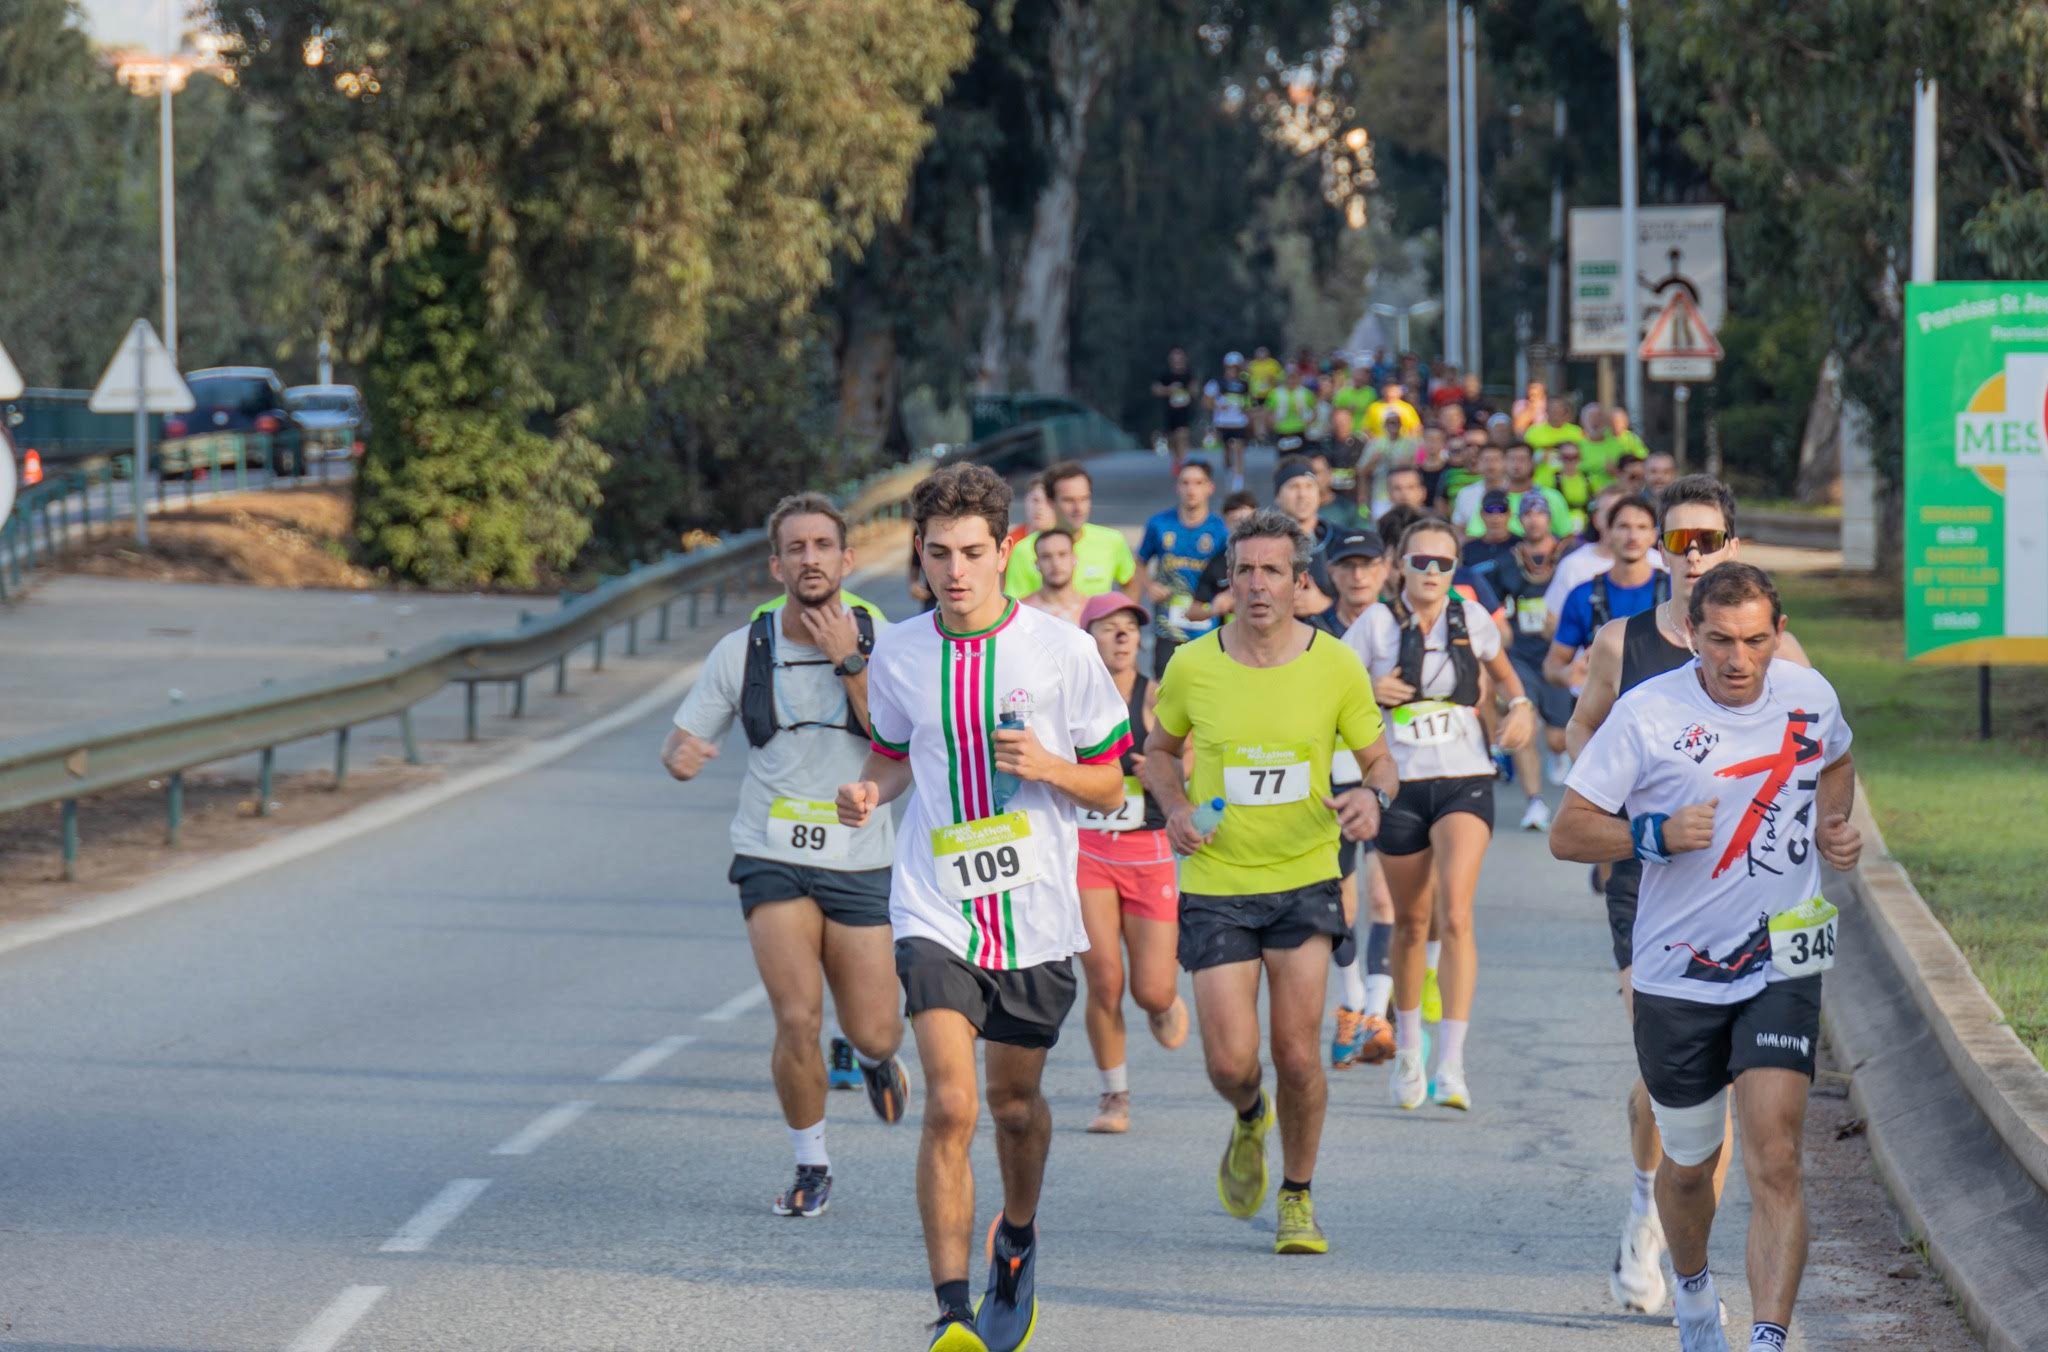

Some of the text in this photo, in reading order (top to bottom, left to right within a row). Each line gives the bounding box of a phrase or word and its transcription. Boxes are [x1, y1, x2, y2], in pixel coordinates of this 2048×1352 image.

[1410, 713, 1449, 739] 117
[1673, 733, 1719, 750] CALVI
[1249, 769, 1286, 795] 77
[791, 825, 826, 850] 89
[1747, 798, 1784, 877] Trail
[952, 846, 1020, 887] 109
[1790, 923, 1835, 964] 348
